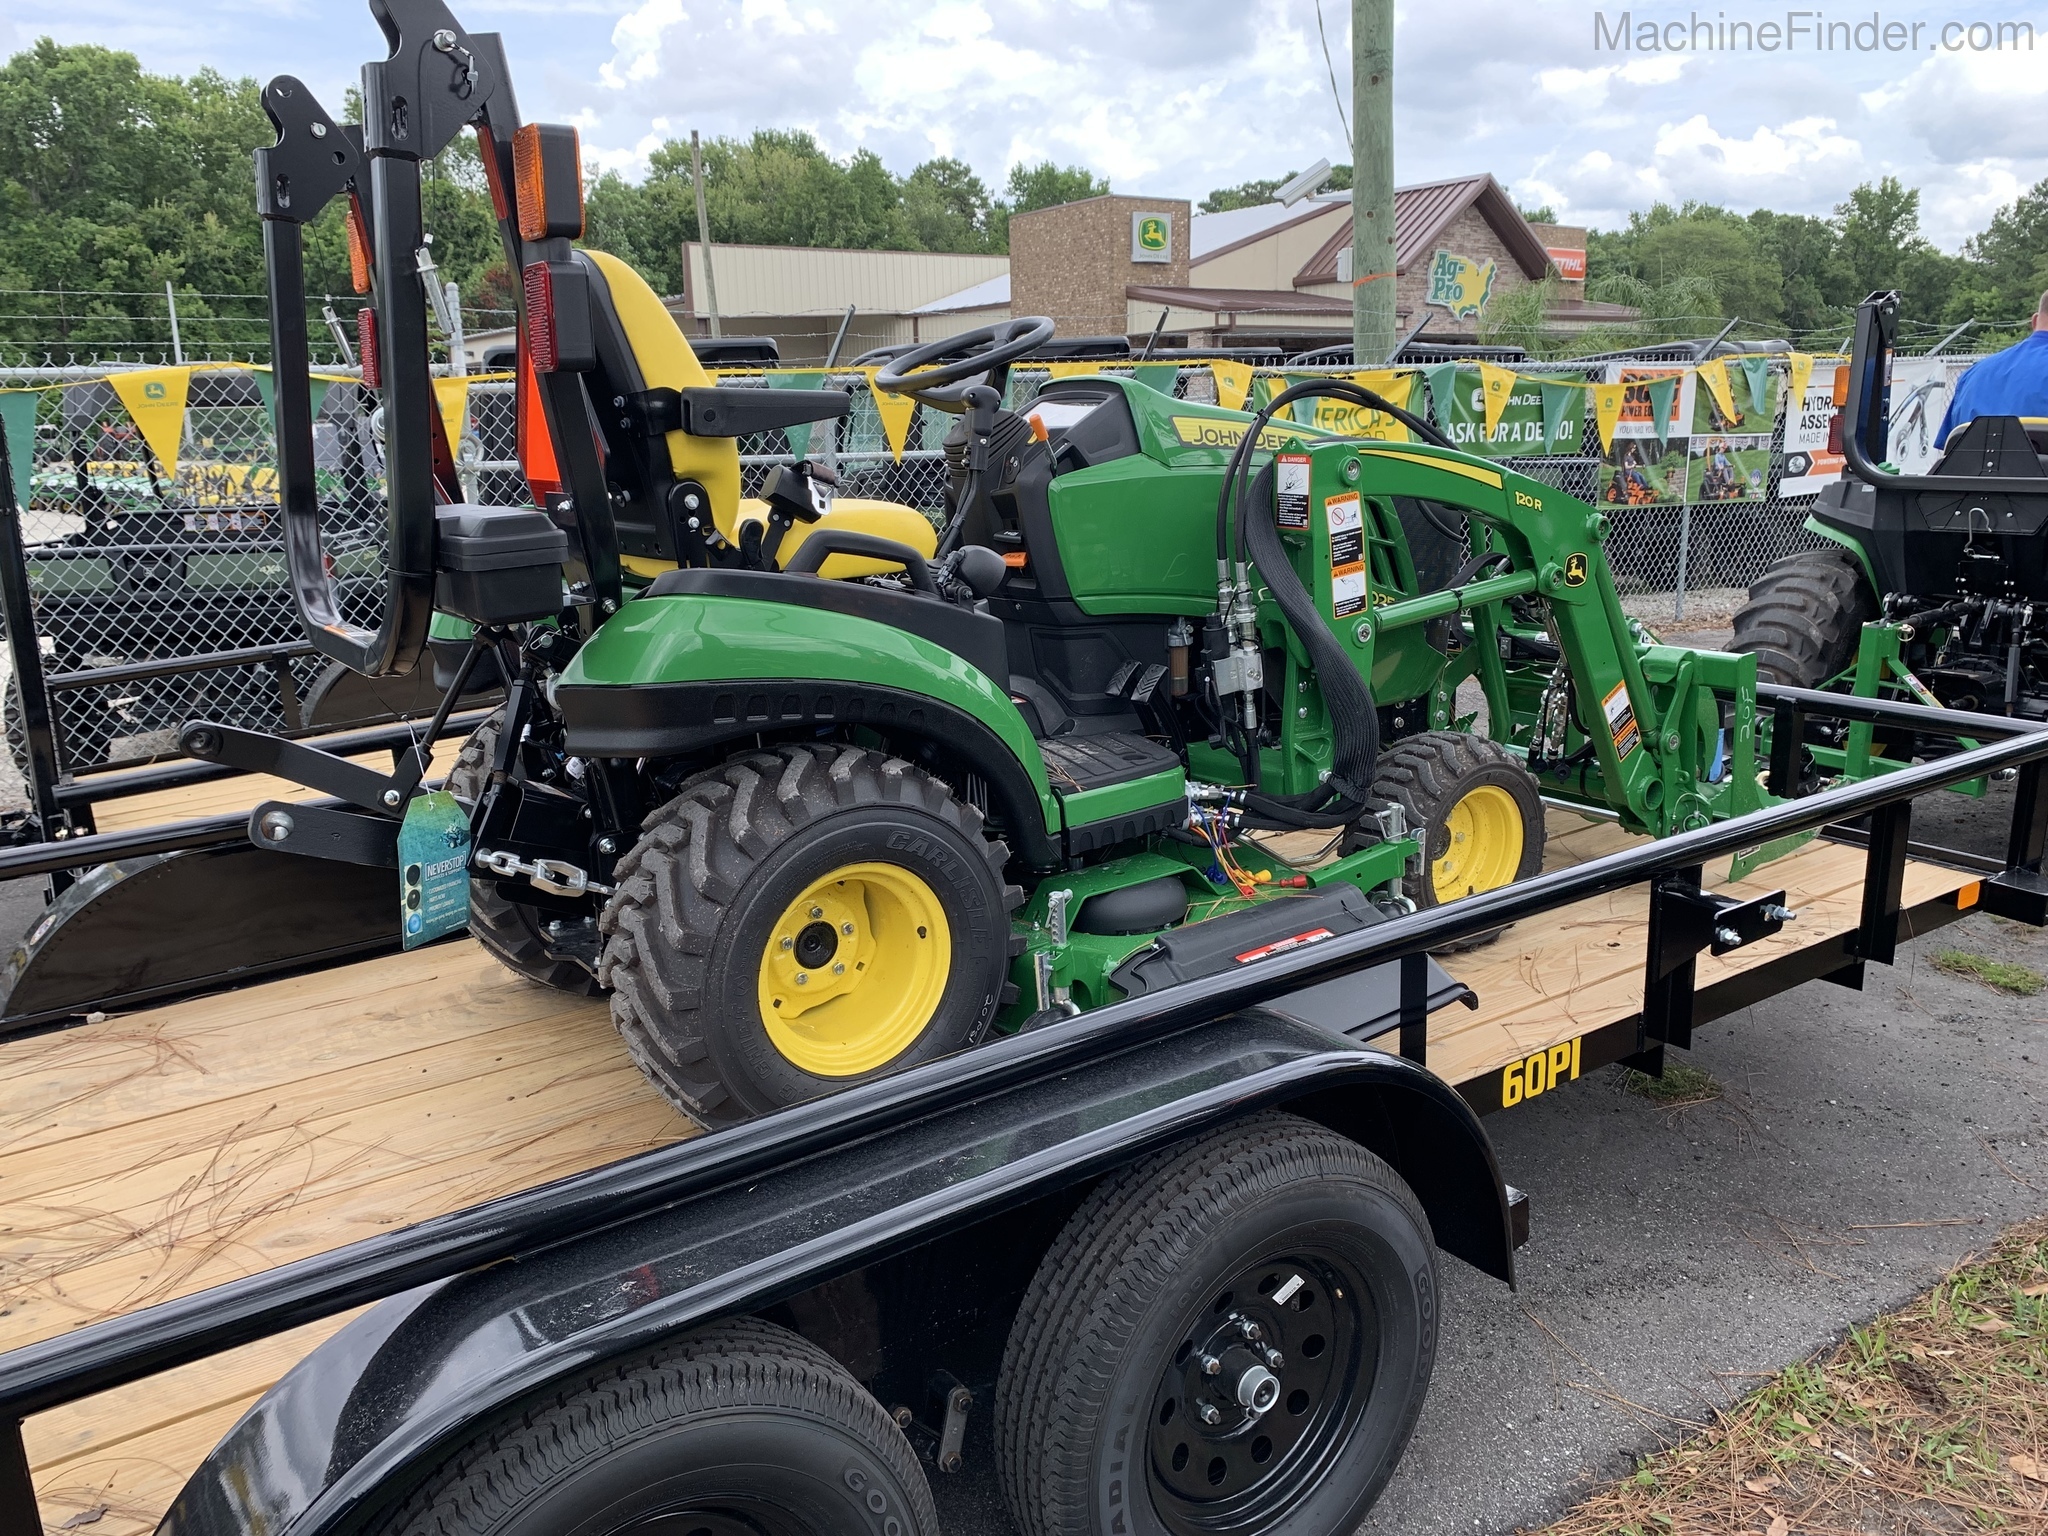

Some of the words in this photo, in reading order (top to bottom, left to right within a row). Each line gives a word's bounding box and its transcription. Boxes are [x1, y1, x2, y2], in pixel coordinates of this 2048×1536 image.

[1433, 252, 1465, 281] Ag-
[1431, 278, 1463, 301] Pro
[1507, 395, 1522, 406] HN
[1522, 393, 1543, 406] DEE
[1285, 401, 1398, 431] AERICAS
[1255, 430, 1289, 449] DEE
[1446, 422, 1476, 444] ASK
[1510, 421, 1521, 442] A
[1524, 420, 1574, 442] DEO!
[1798, 431, 1821, 444] MADE
[1287, 456, 1307, 464] DANGER
[1331, 492, 1358, 504] WARNING
[1514, 490, 1534, 508] 120
[1534, 498, 1542, 512] R
[1338, 563, 1364, 576] WARNING
[427, 855, 464, 877] NEVERSTOP
[886, 830, 989, 950] CARLISLE
